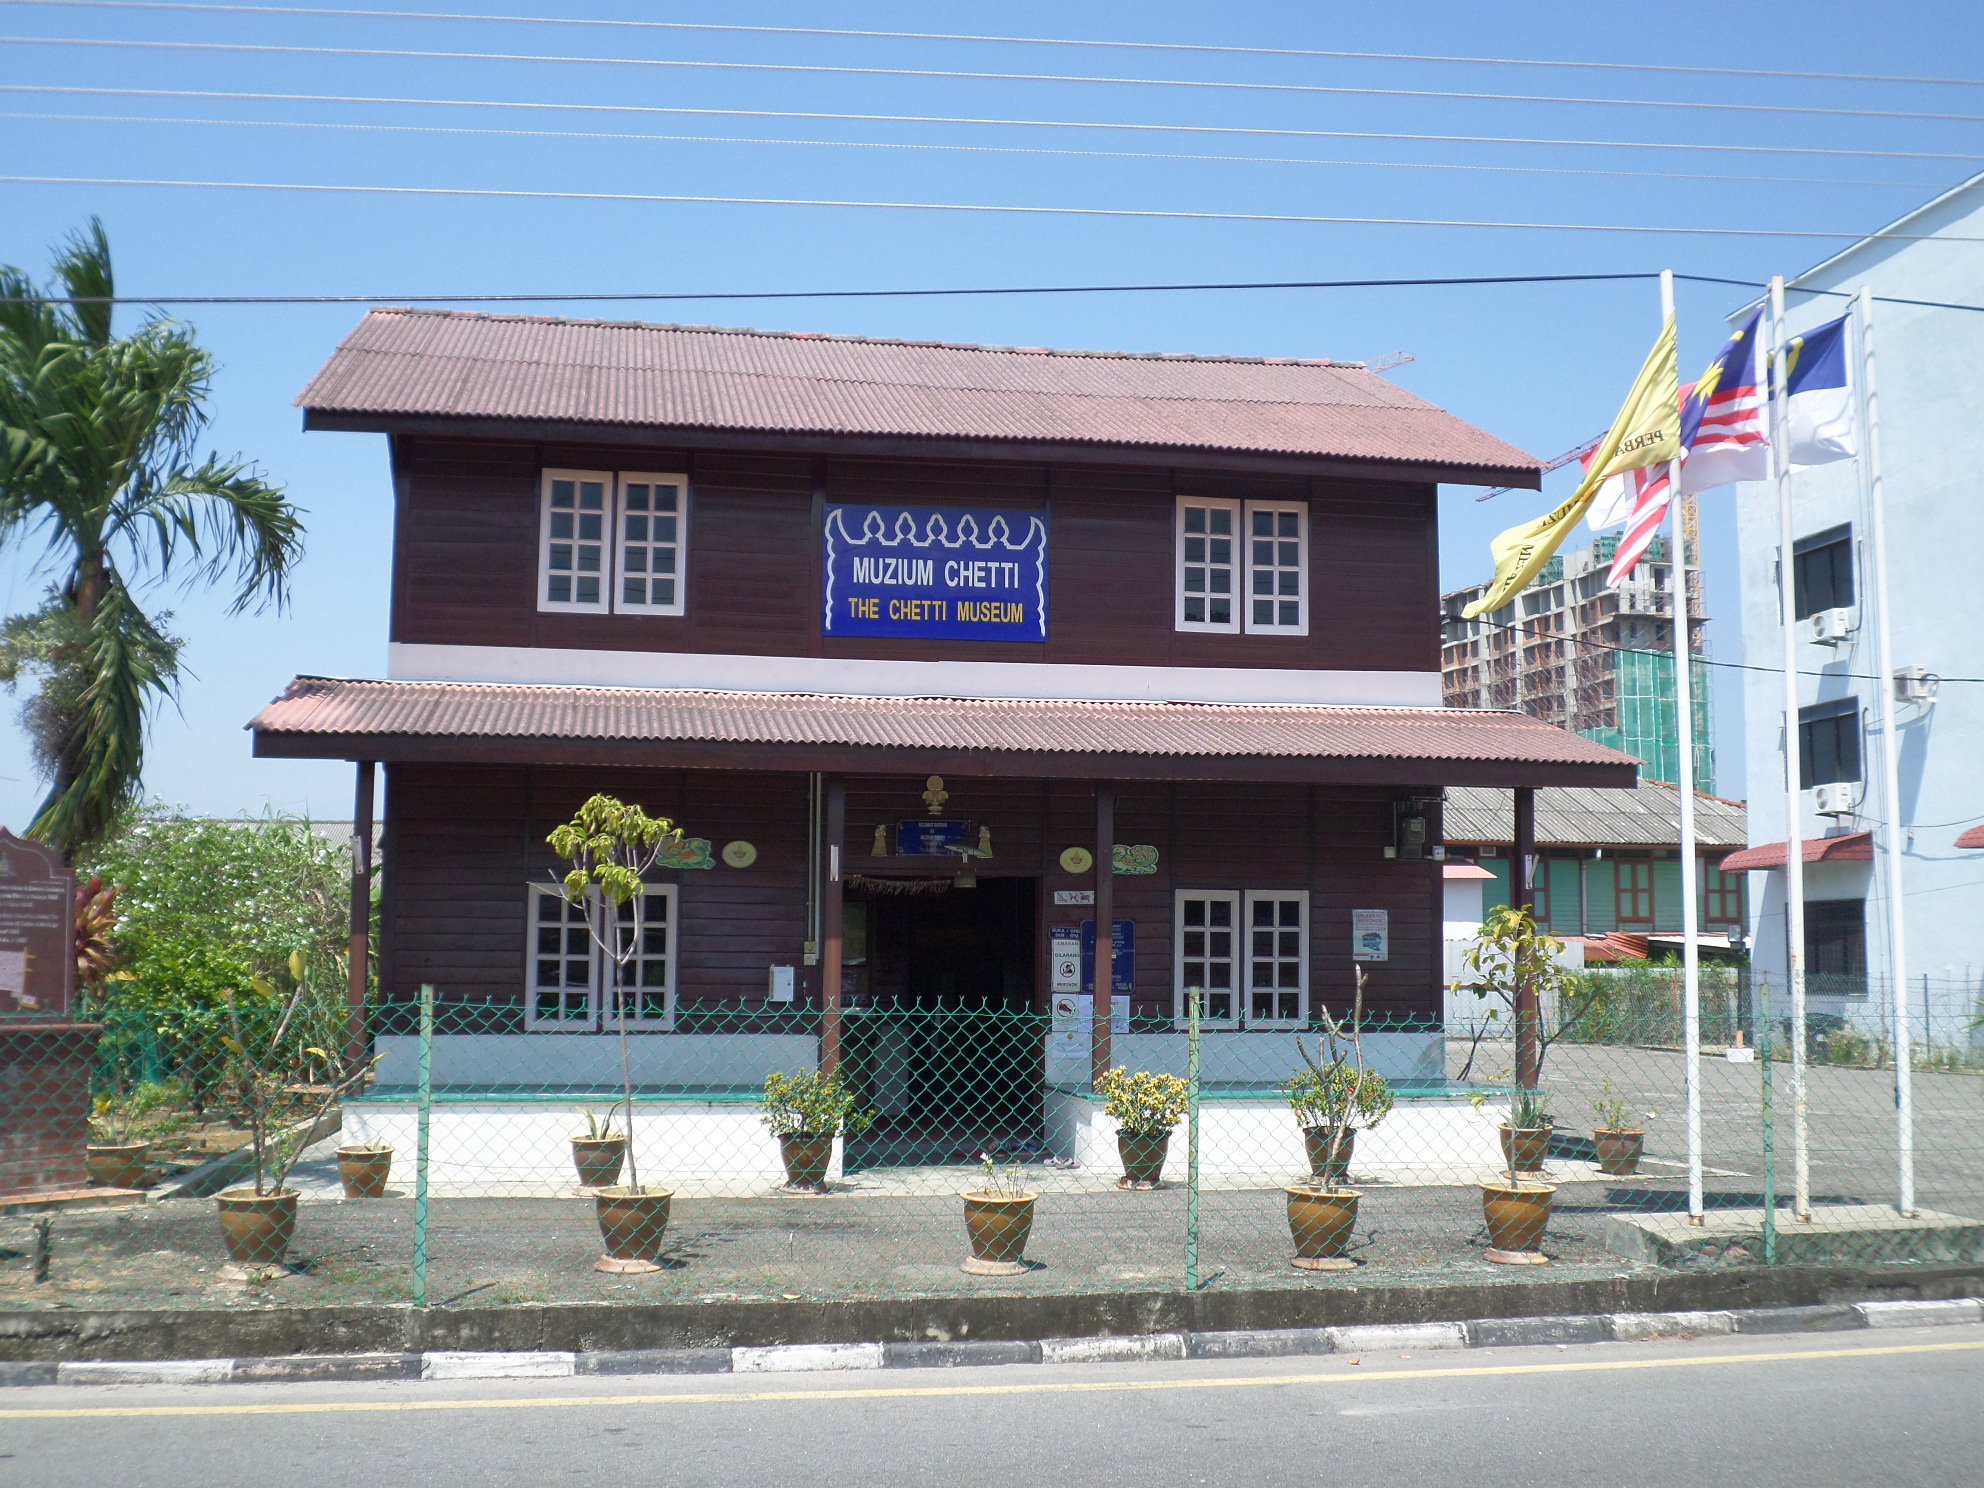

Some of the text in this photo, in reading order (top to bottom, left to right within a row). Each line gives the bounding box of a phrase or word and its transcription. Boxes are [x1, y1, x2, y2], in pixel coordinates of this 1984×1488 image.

[853, 556, 1019, 589] MUZIUM CHETTI
[848, 597, 1023, 623] THE CHETTI MUSEUM
